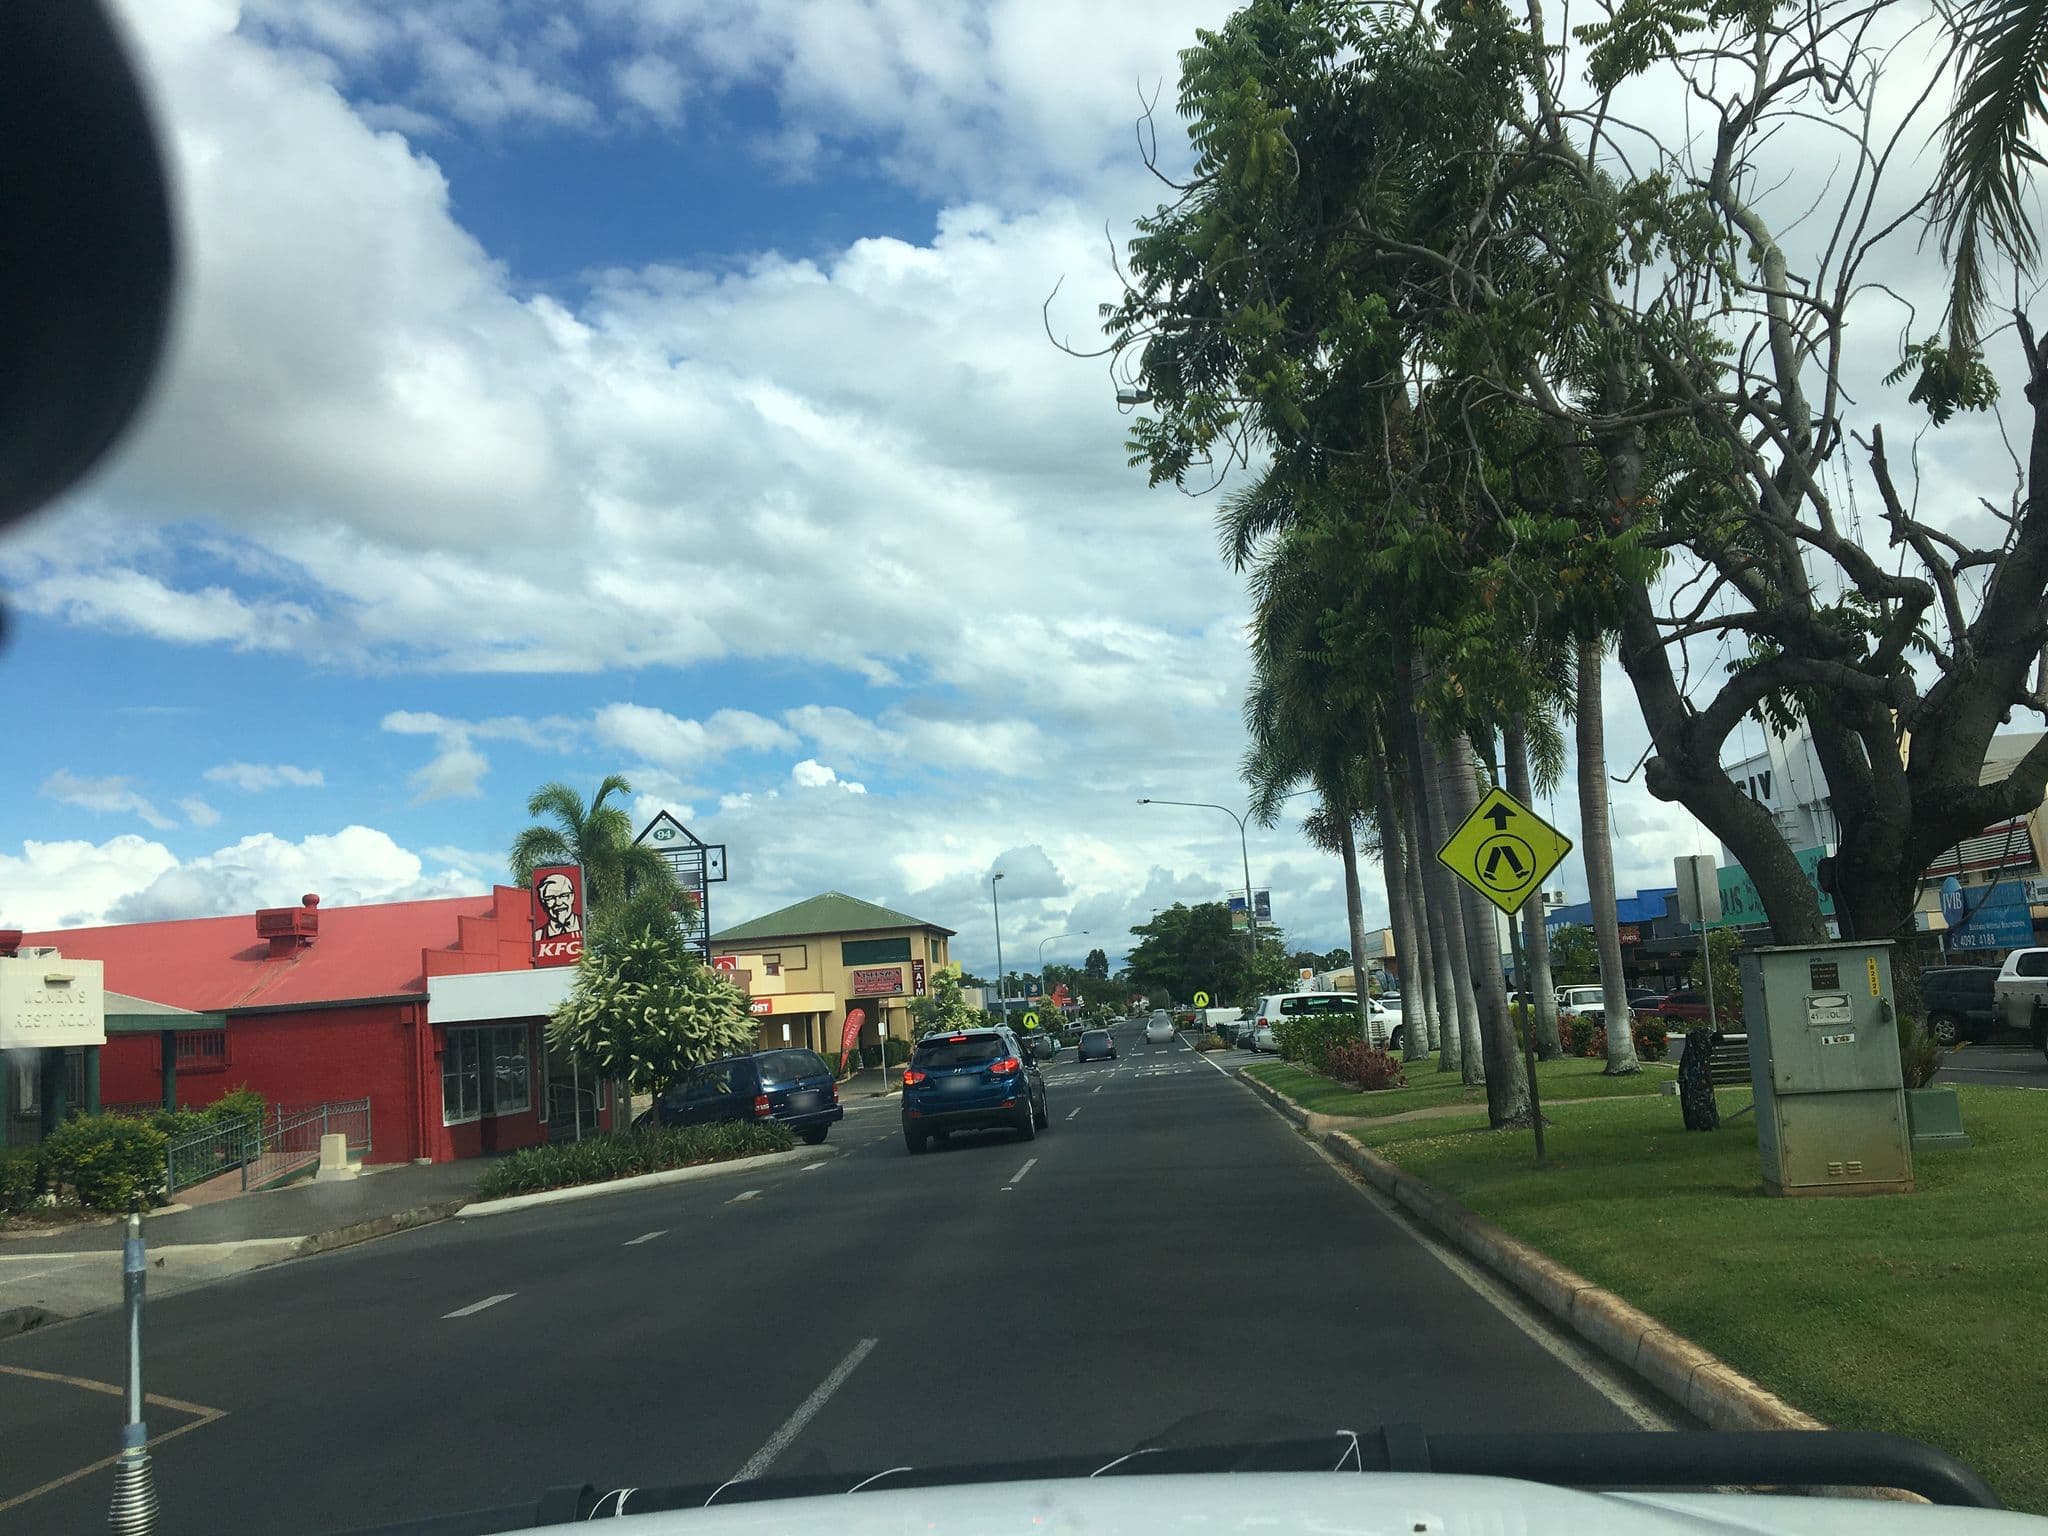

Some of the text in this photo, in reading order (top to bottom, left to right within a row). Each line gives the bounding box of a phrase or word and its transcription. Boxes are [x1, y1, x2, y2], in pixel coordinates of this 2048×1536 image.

[657, 830, 671, 839] 94
[1960, 934, 1976, 946] 4092
[537, 941, 580, 957] KFC
[915, 971, 925, 997] ATM
